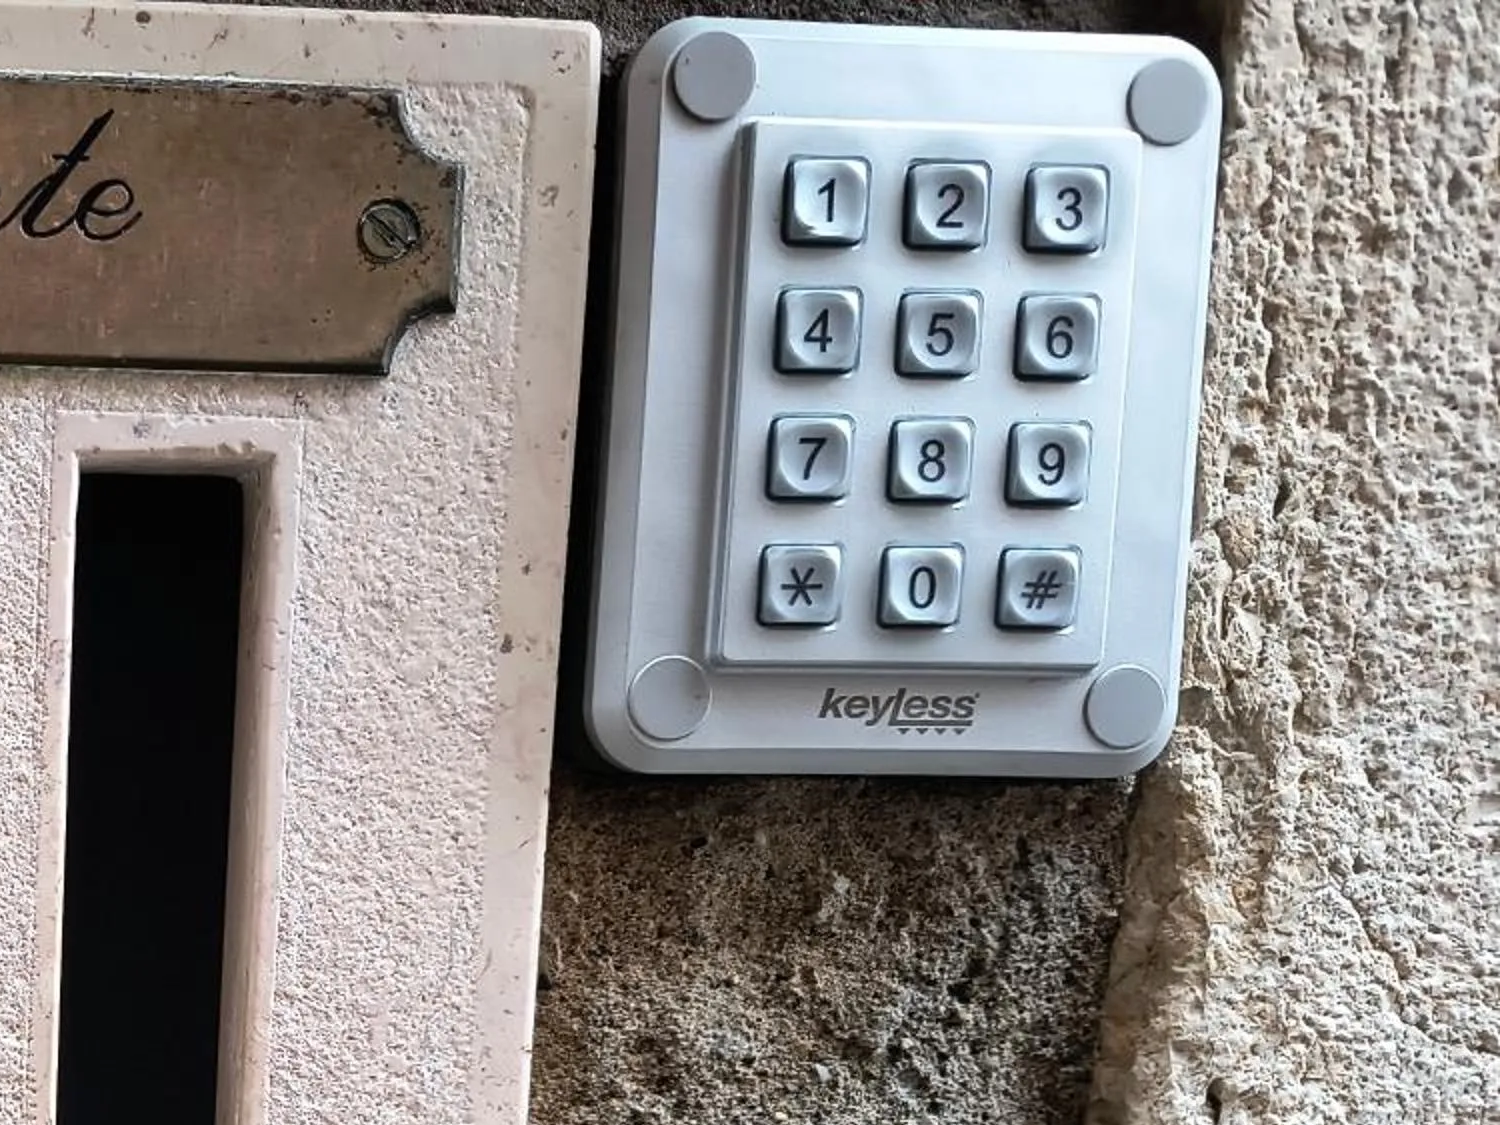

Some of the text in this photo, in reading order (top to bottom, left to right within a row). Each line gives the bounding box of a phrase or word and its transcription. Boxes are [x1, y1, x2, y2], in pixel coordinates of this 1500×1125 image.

[815, 178, 1083, 232] 1 2 3
[802, 309, 1074, 359] 4 5 6
[799, 438, 1066, 487] 7 8 9
[908, 567, 937, 609] 0
[818, 687, 977, 728] keyless
